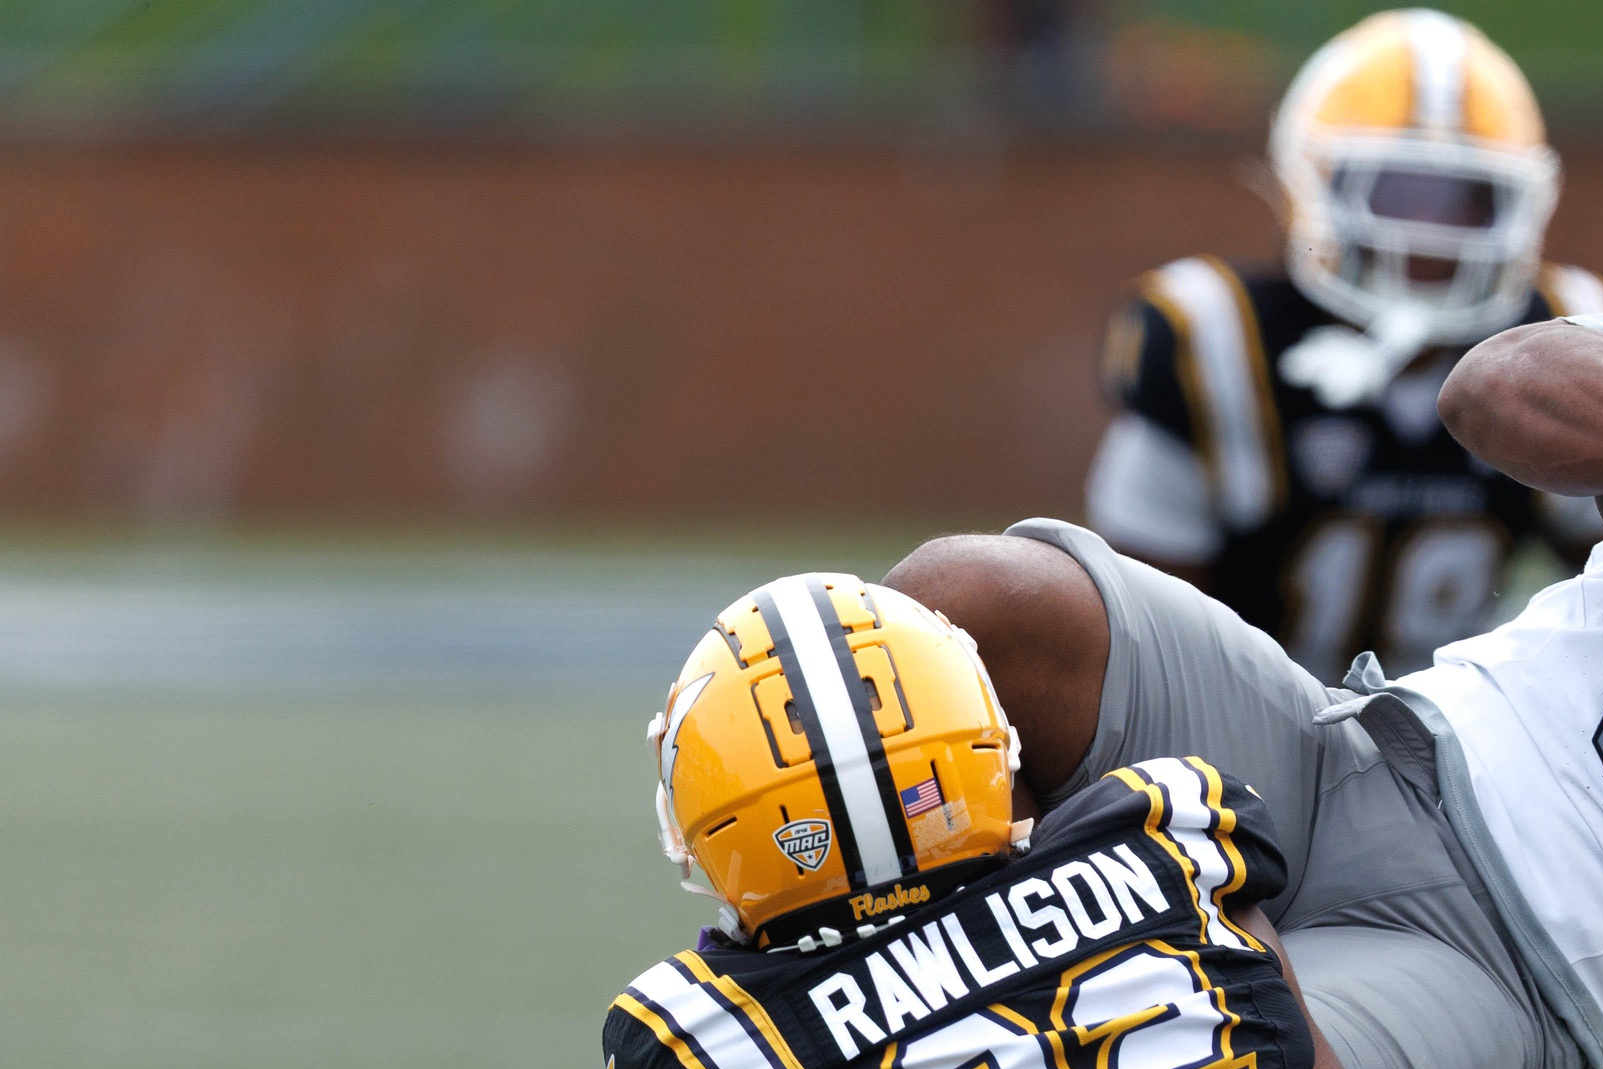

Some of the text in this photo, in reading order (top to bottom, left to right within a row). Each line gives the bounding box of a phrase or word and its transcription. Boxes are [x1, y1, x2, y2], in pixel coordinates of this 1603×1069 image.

[783, 832, 830, 855] MAC
[848, 884, 931, 921] Flashes
[807, 843, 1170, 1061] RAWLISON
